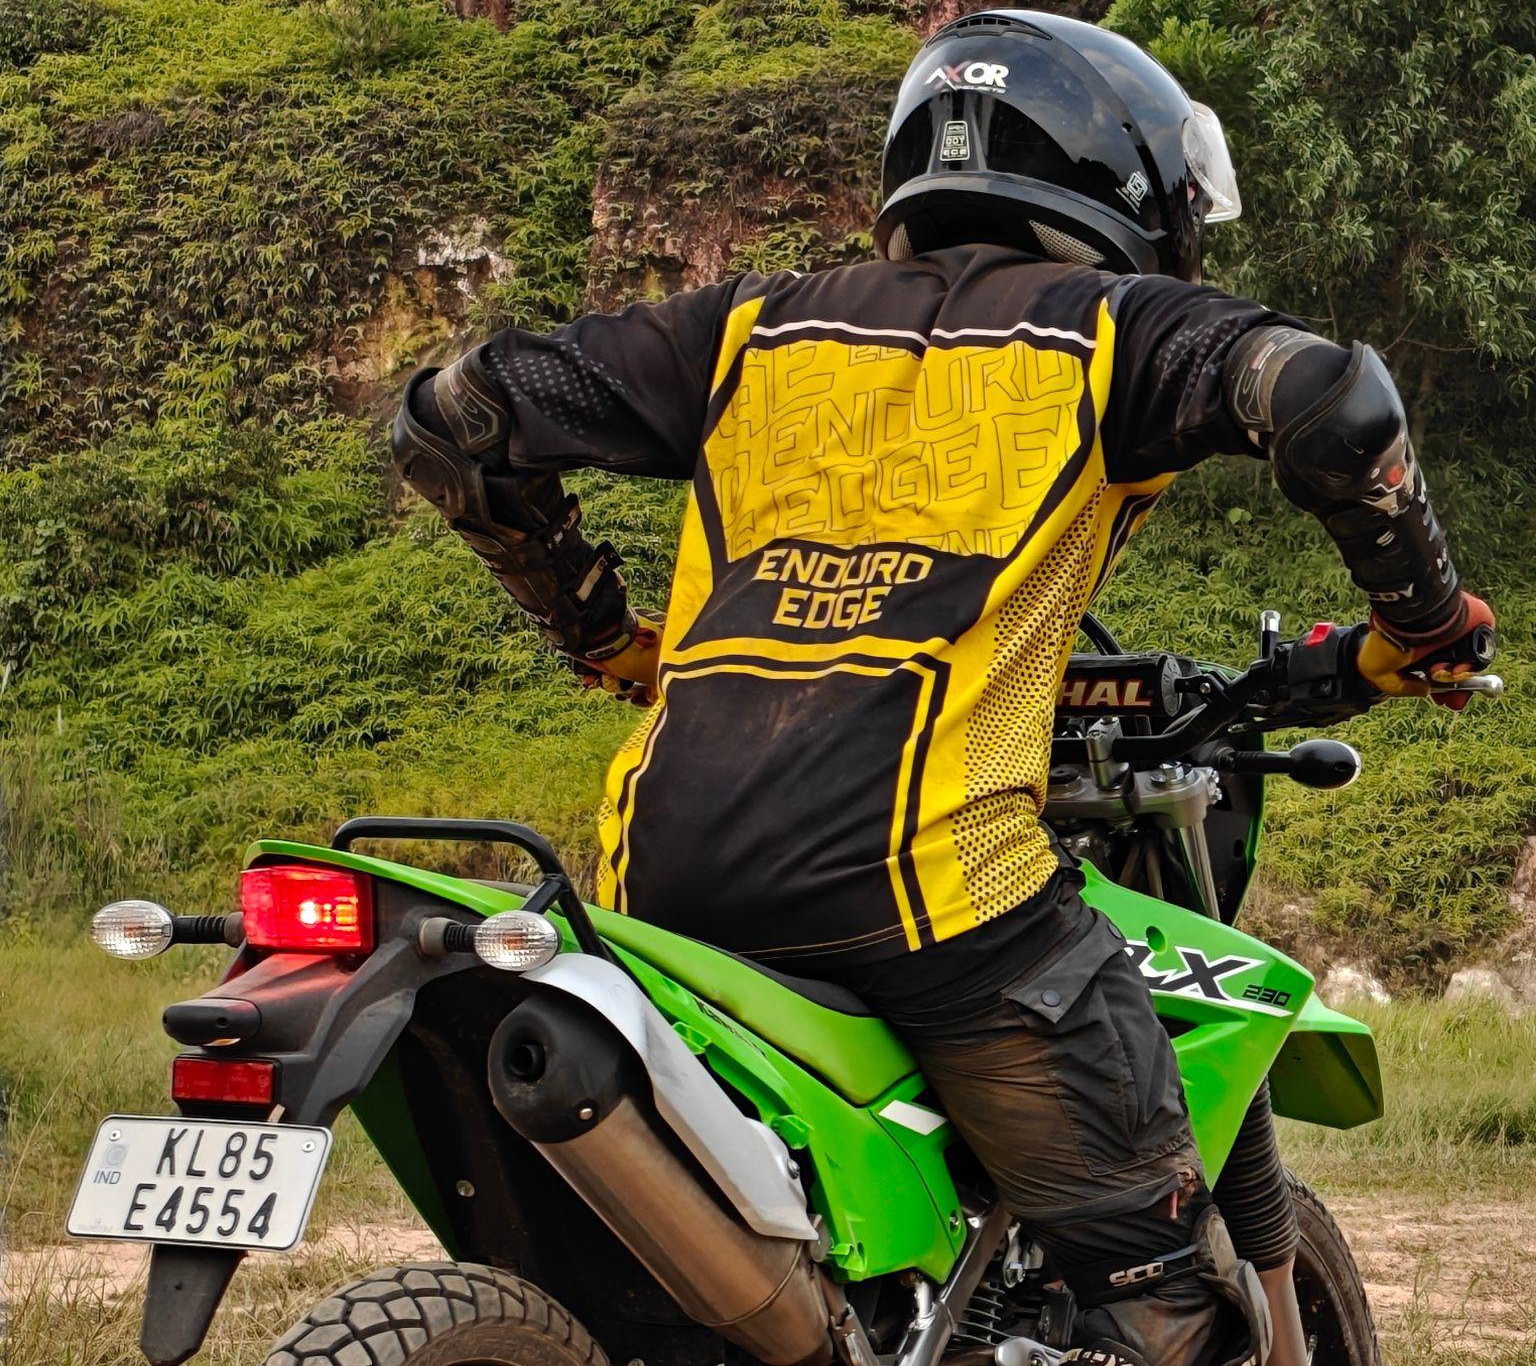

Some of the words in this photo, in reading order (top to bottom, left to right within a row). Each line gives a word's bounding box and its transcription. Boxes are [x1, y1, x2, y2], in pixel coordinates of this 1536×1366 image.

[924, 60, 1010, 91] AXOR
[751, 547, 935, 590] ENDURO
[771, 585, 894, 632] EDGE
[1242, 983, 1292, 1007] 230
[155, 1127, 279, 1181] KL85
[93, 1170, 122, 1186] IND
[122, 1182, 279, 1239] E4554
